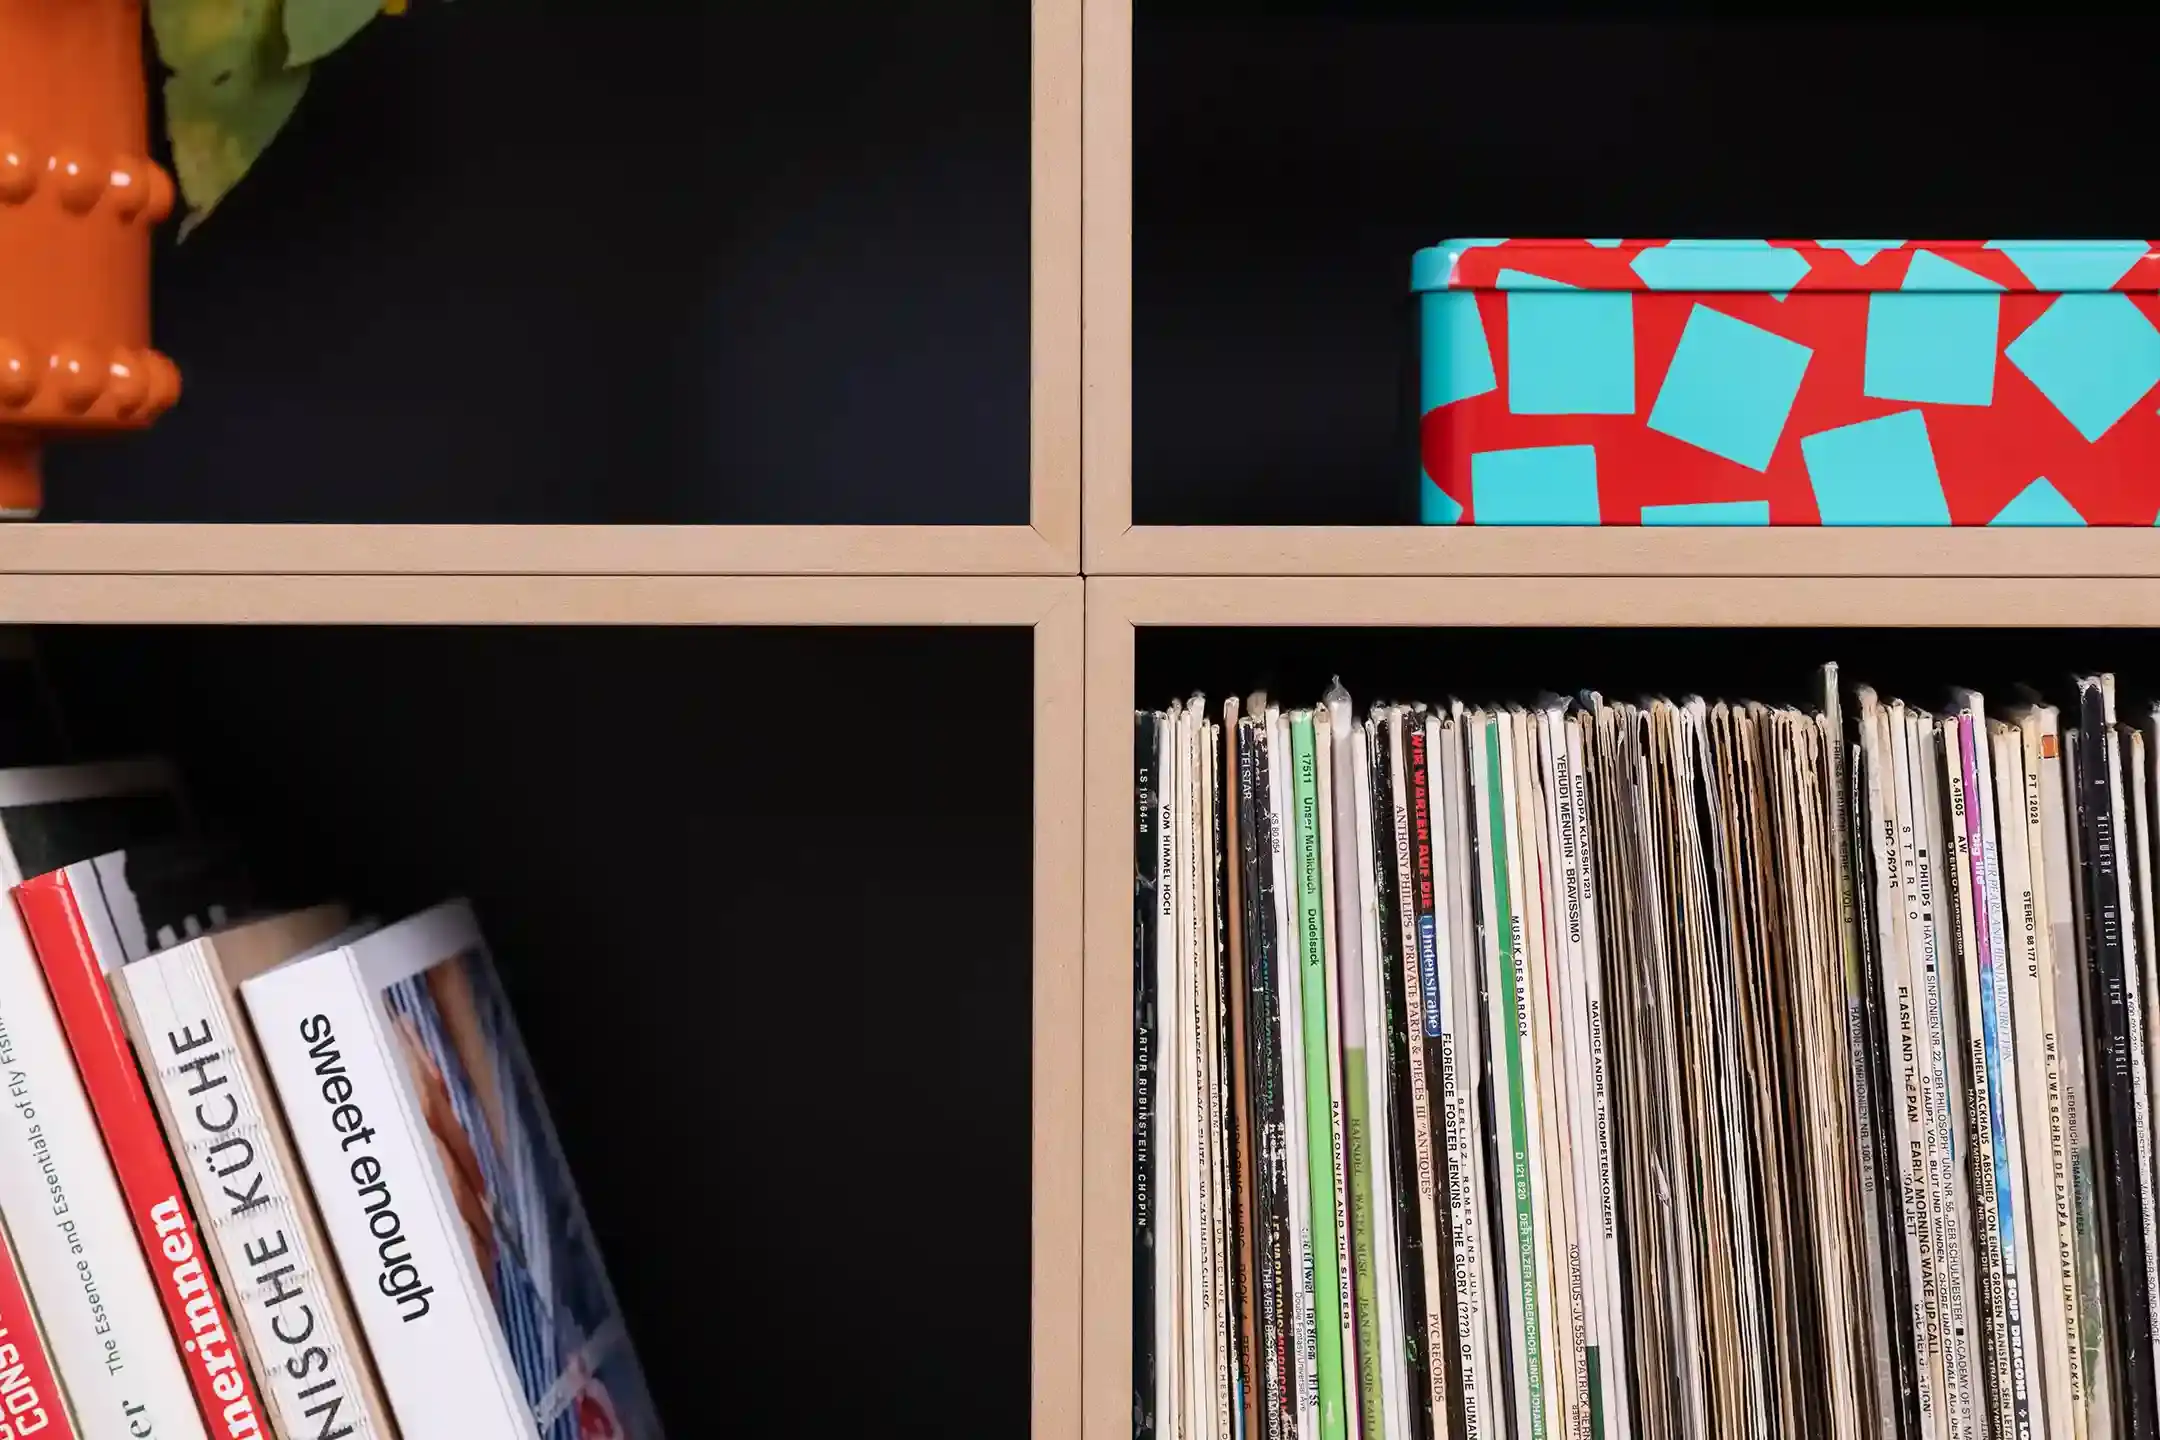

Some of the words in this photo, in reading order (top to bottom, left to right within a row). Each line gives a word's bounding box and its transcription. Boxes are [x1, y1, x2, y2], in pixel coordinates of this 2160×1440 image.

[1302, 753, 1312, 783] 17511
[1411, 734, 1423, 764] WIR
[1140, 769, 1148, 783] LS
[1556, 754, 1569, 799] YEHUDI
[2028, 774, 2037, 788] PT
[1303, 797, 1314, 830] Unser
[1413, 769, 1427, 840] WARTEN
[1575, 775, 1585, 823] EUROPA
[1952, 777, 1964, 817] 6.41505
[2030, 794, 2040, 824] 12028
[1162, 804, 1171, 830] VOM
[1271, 812, 1279, 825] KS
[1560, 802, 1572, 858] MENUHIN
[1396, 805, 1408, 868] ANTHONY
[1579, 825, 1589, 875] KLASSIK
[1957, 835, 1967, 854] AW
[1162, 835, 1171, 879] HIMMEL
[1305, 835, 1316, 894] Musikbuch
[1418, 844, 1430, 877] AUF
[1902, 826, 1918, 920] STEREO
[1162, 884, 1171, 916] HOCH
[1400, 872, 1412, 928] PHILLIPS
[1421, 881, 1431, 909] DIE
[1583, 878, 1591, 899] 1213
[1919, 864, 1930, 906] PHILIPS
[1946, 842, 1964, 955] STEREO-Transcription
[1566, 868, 1580, 942] BRAVISSIMO
[2023, 891, 2034, 931] STEREO
[1307, 909, 1319, 966] Dudelsack
[1511, 916, 1522, 954] MUSIK
[1923, 925, 1933, 961] HAYDN
[2026, 935, 2035, 946] 88
[1405, 944, 1417, 998] PRIVATE
[1514, 959, 1524, 983] DES
[2027, 947, 2036, 962] 177
[2028, 965, 2037, 979] DY
[1898, 986, 1911, 1030] FLASH
[1926, 976, 1939, 1028] SINFONIEN
[2109, 978, 2122, 1006] INCH
[1409, 1002, 1420, 1041] PARTS
[1517, 988, 1527, 1037] BAROCK
[1591, 1000, 1601, 1054] MAURICE
[1850, 1007, 1861, 1047] HAYDN:
[1138, 1028, 1147, 1071] ARTUR
[1412, 1046, 1422, 1055] &
[1902, 1035, 1913, 1061] AND
[1931, 1032, 1940, 1048] NR.
[1932, 1050, 1942, 1062] 22
[2044, 1033, 2055, 1066] UWE,
[2114, 1036, 2127, 1076] SINGLE
[1413, 1060, 1425, 1101] PIECES
[1442, 1033, 1454, 1097] FLORENCE
[1595, 1057, 1604, 1097] ANDRE
[1904, 1067, 1916, 1091] THE
[1972, 1039, 1985, 1084] WILHELM
[8, 1069, 28, 1097] Fly
[1853, 1050, 1866, 1119] SYMPHONIEN
[2048, 1072, 2058, 1101] UWE
[15, 1099, 36, 1120] of
[168, 1019, 269, 1215] KÜCHE
[1138, 1078, 1147, 1162] RUBINSTEIN
[1416, 1105, 1426, 1119] III
[1446, 1104, 1457, 1151] FOSTER
[1907, 1095, 1918, 1123] PAN
[1976, 1089, 1990, 1145] BACKHAUS
[2066, 1086, 2078, 1145] LIEDERBUCH
[1458, 1098, 1467, 1167] BERLIOZ:
[1860, 1123, 1869, 1140] NR.
[1927, 1130, 1936, 1154] VOLL
[2050, 1106, 2062, 1156] SCHRIE
[27, 1123, 68, 1216] Essentials
[299, 1013, 376, 1152] sweet
[350, 1156, 434, 1323] enough
[1516, 1163, 1525, 1179] 121
[1861, 1144, 1870, 1161] 100
[1864, 1165, 1872, 1173] &
[1910, 1141, 1924, 1184] EARLY
[1942, 1157, 1952, 1180] UND
[2055, 1163, 2064, 1179] DE
[2070, 1148, 2080, 1188] HERMAN
[1449, 1157, 1460, 1209] JENKINS
[1517, 1181, 1526, 1200] 820
[1598, 1106, 1613, 1239] TROMPETENKONZERTE
[1930, 1160, 1940, 1187] BLUT
[1943, 1183, 1953, 1200] NR.
[1982, 1153, 1994, 1203] ABSCHIED
[1138, 1174, 1147, 1226] CHOPIN
[1463, 1176, 1472, 1226] ROMEO
[1932, 1191, 1941, 1213] UND
[58, 1219, 84, 1255] and
[1333, 1133, 1343, 1194] CONNIFF
[1340, 1267, 1349, 1329] SINGERS
[1453, 1224, 1462, 1248] THE
[1519, 1213, 1529, 1235] DER
[1905, 1208, 1917, 1237] JETT
[1914, 1189, 1930, 1254] MORNING
[1986, 1208, 1996, 1231] VON
[1467, 1235, 1476, 1264] UND
[1934, 1217, 1945, 1263] WUNDEN
[1988, 1235, 2000, 1268] EINEM
[1455, 1254, 1466, 1295] GLORY
[1570, 1243, 1582, 1300] AQUARIUS
[1921, 1257, 1933, 1297] WAKE
[2060, 1242, 2071, 1278] ADAM
[77, 1260, 110, 1335] Essence
[1470, 1272, 1479, 1314] JULIA
[1924, 1301, 1935, 1319] UP
[1992, 1272, 2004, 1318] GROSSEN
[2006, 1279, 2020, 1321] SOUP
[2063, 1284, 2073, 1311] UND
[1429, 1313, 1440, 1338] PVC
[1457, 1301, 1470, 1338] (????)
[1523, 1281, 1536, 1355] KNABENCHOR
[1573, 1308, 1582, 1323] JV
[1942, 1313, 1950, 1335] UND
[2066, 1318, 2075, 1339] DIE
[104, 1339, 124, 1376] The
[1462, 1345, 1471, 1360] OF
[1575, 1325, 1585, 1352] 5555
[1927, 1323, 1939, 1358] CALL
[1995, 1323, 2009, 1375] PIANISTEN
[1431, 1343, 1444, 1402] RECORDS
[1464, 1367, 1474, 1391] THE
[1529, 1358, 1539, 1388] SINGT
[1956, 1339, 1969, 1389] ACADEMY
[2010, 1325, 2026, 1400] DRAGONS
[2069, 1346, 2080, 1401] MICKY'S
[1578, 1359, 1590, 1407] PATRICK
[1961, 1392, 1970, 1404] OF
[2001, 1387, 2011, 1410] SEIN
[1466, 1397, 1478, 1440] HUMAN
[1531, 1392, 1542, 1435] JOHANN
[1961, 1407, 1972, 1420] ST.
